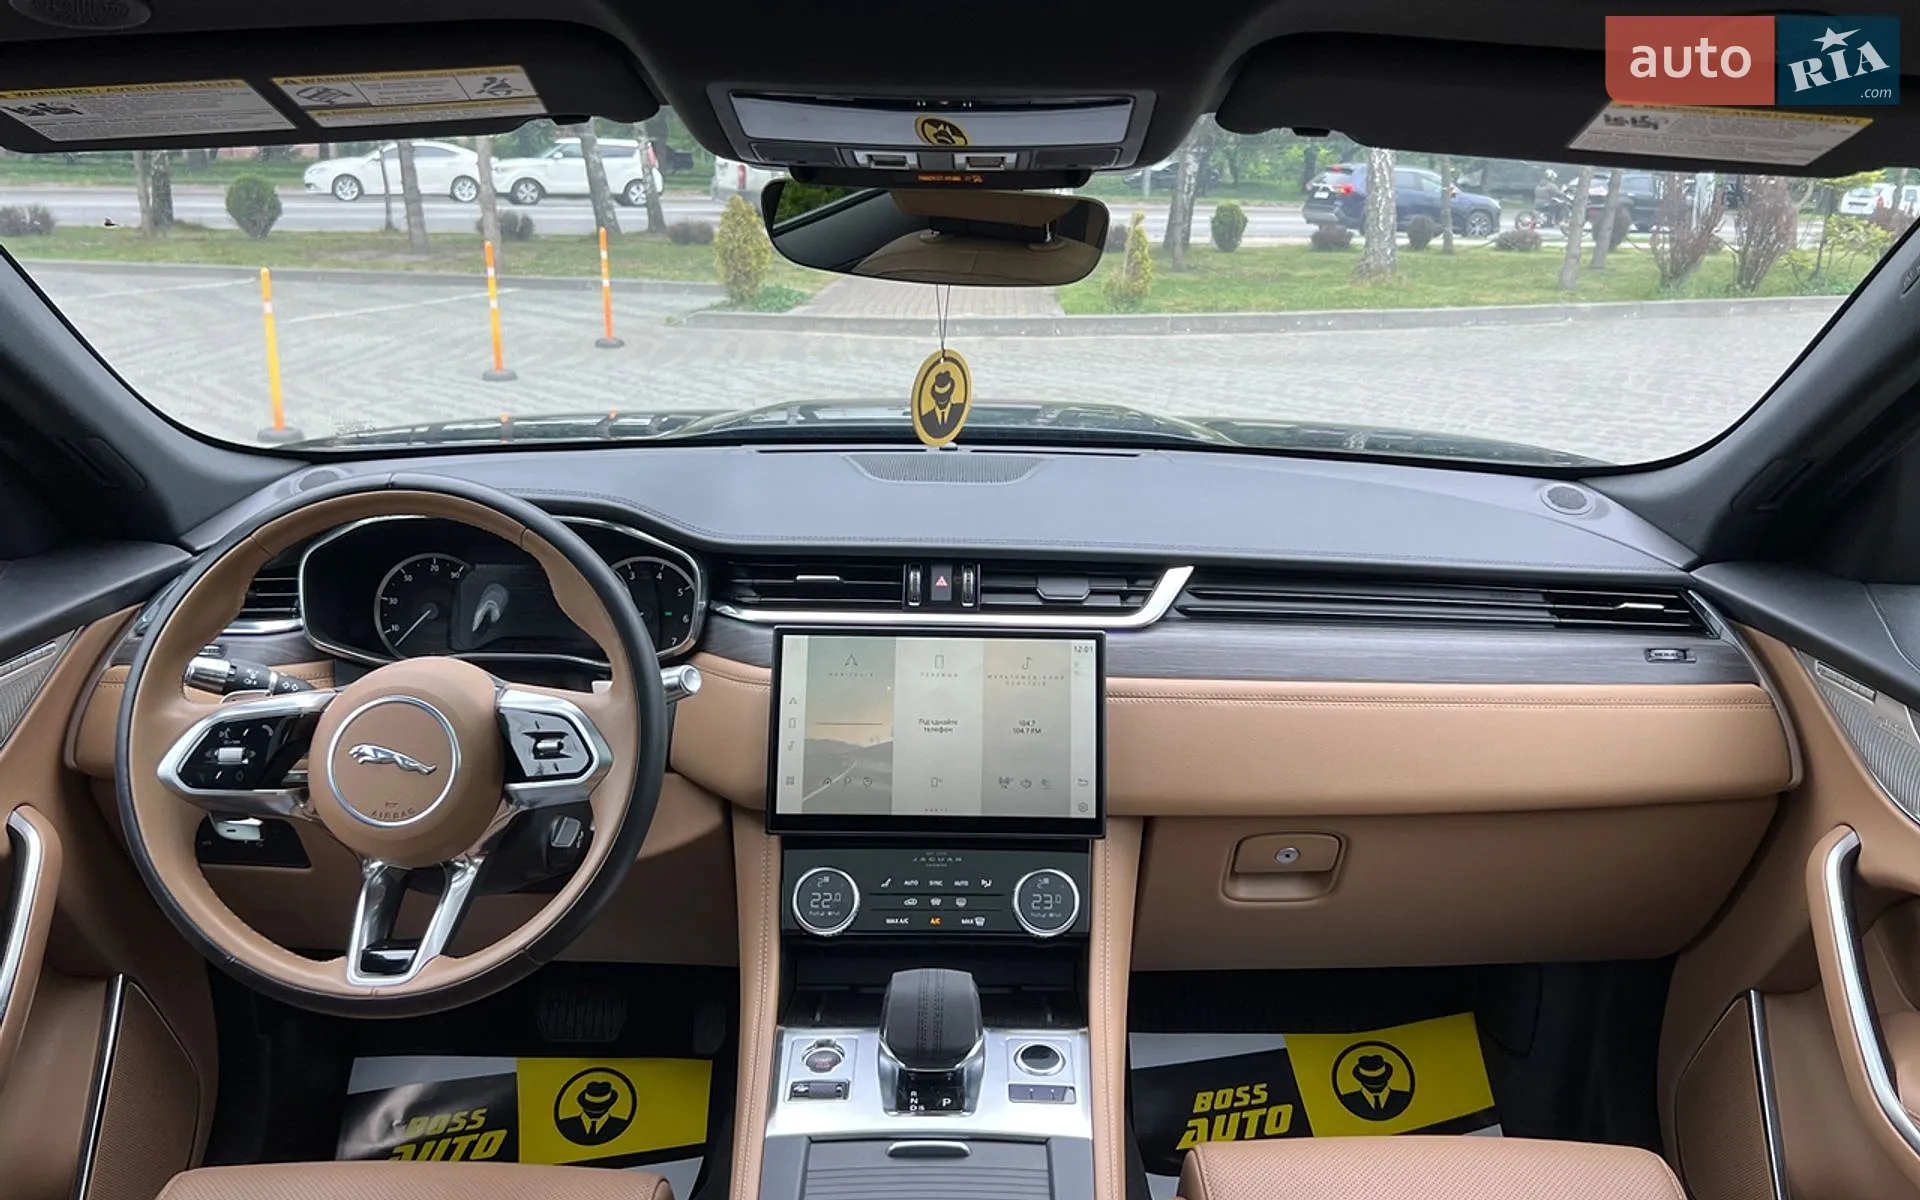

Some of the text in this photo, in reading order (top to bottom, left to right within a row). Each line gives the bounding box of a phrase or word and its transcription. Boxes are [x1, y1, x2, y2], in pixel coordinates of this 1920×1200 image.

[655, 571, 663, 581] 4
[677, 588, 684, 597] 5
[682, 613, 690, 624] 6
[671, 636, 678, 646] 7
[942, 1097, 952, 1107] P
[1193, 1083, 1268, 1113] BOSS
[1175, 1103, 1293, 1151] AUTO
